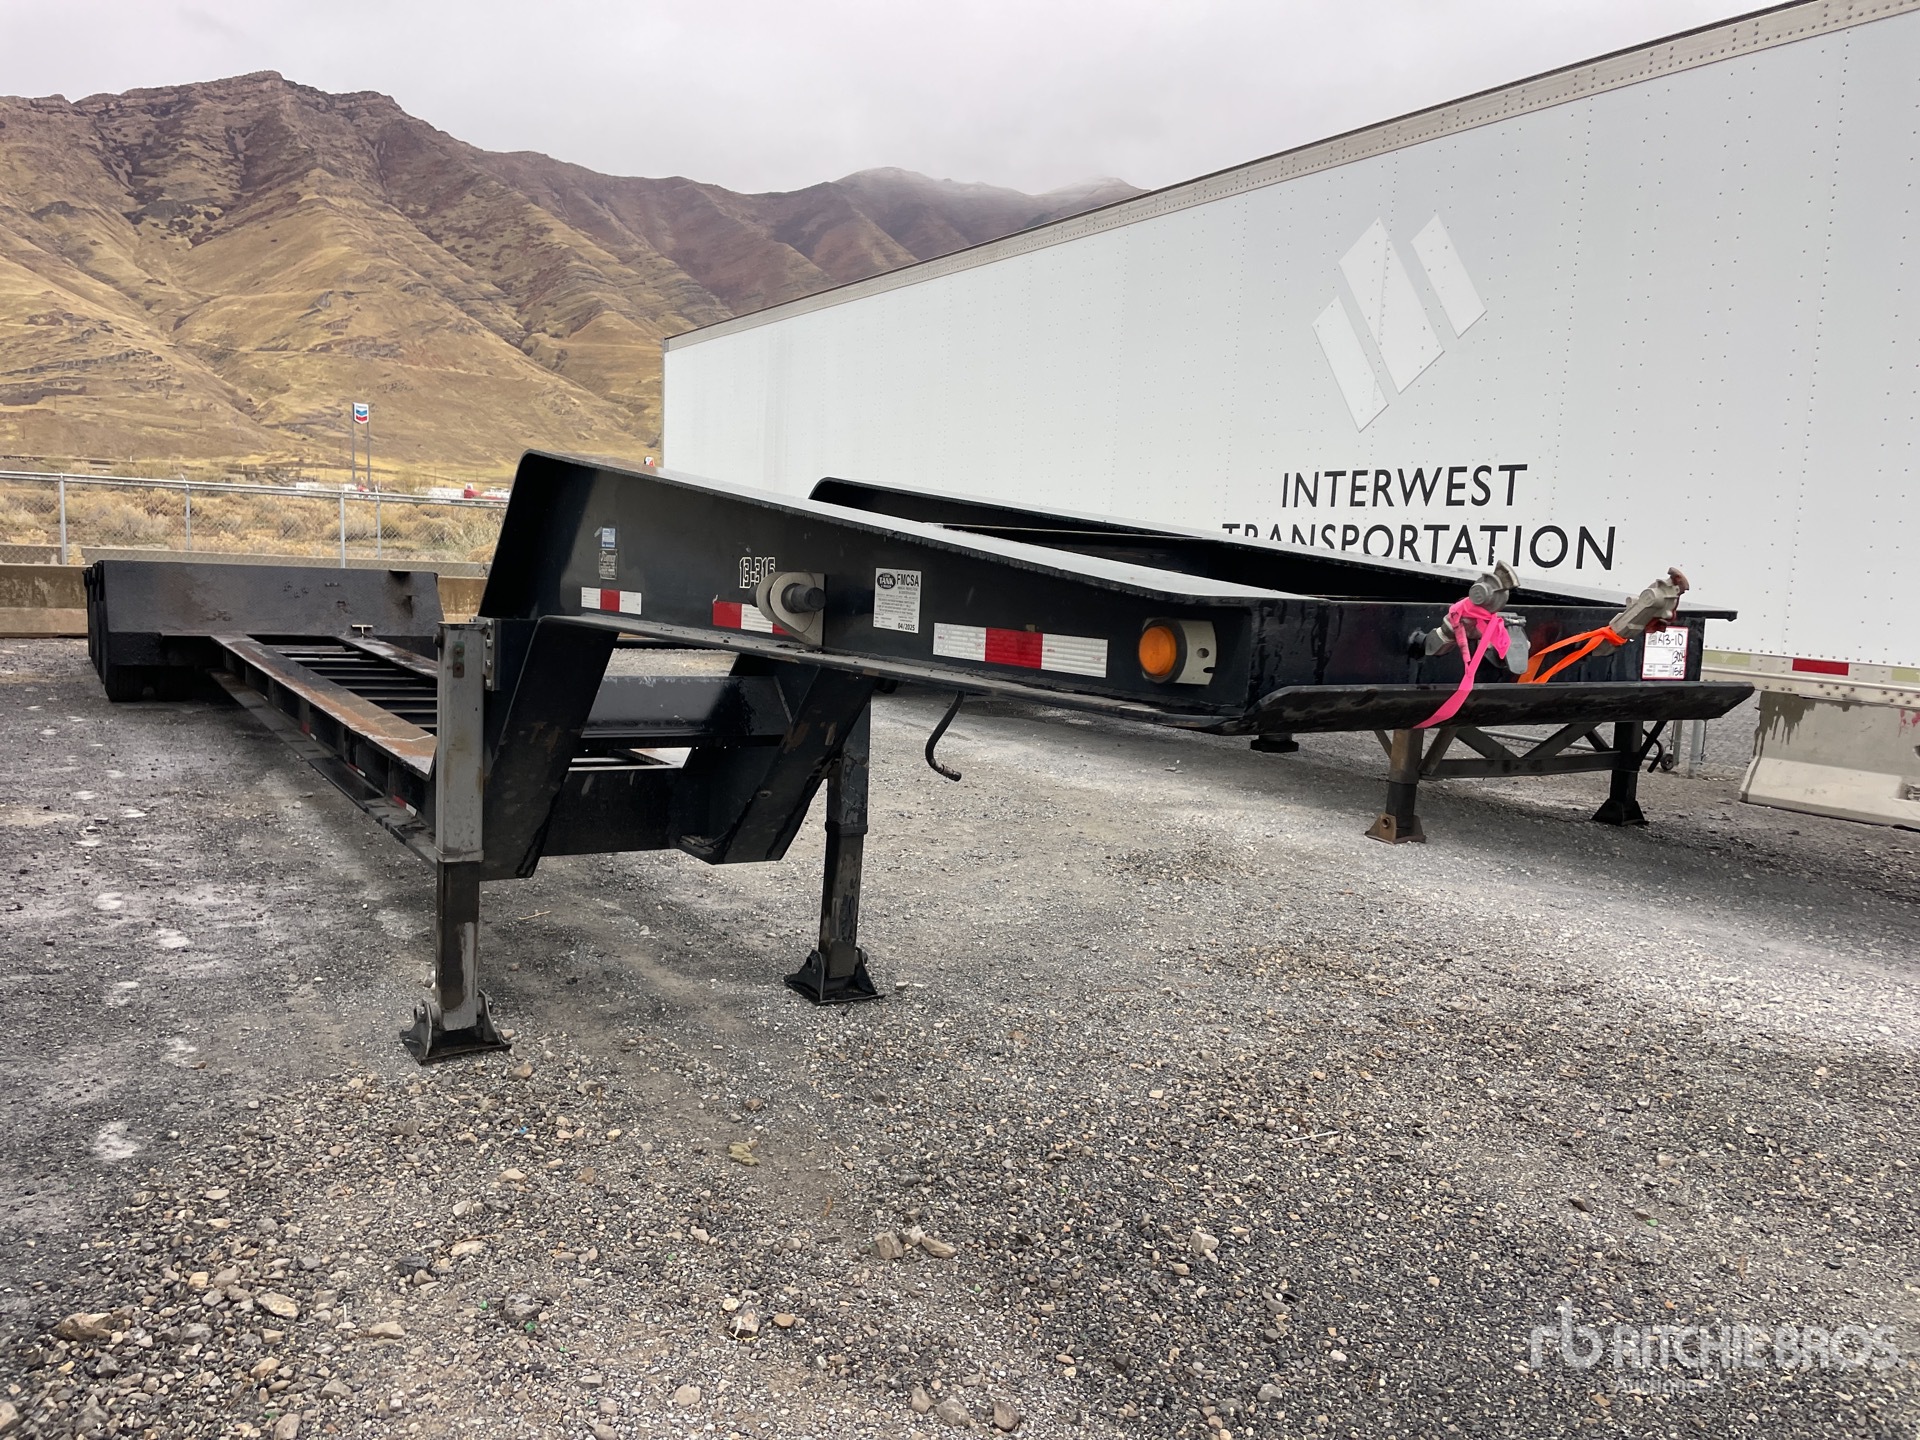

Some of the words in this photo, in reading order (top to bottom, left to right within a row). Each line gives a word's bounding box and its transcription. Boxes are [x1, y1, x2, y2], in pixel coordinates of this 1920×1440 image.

[1282, 464, 1527, 508] INTERWEST
[1222, 524, 1616, 570] NSPORTATION
[896, 573, 920, 587] FMCSA
